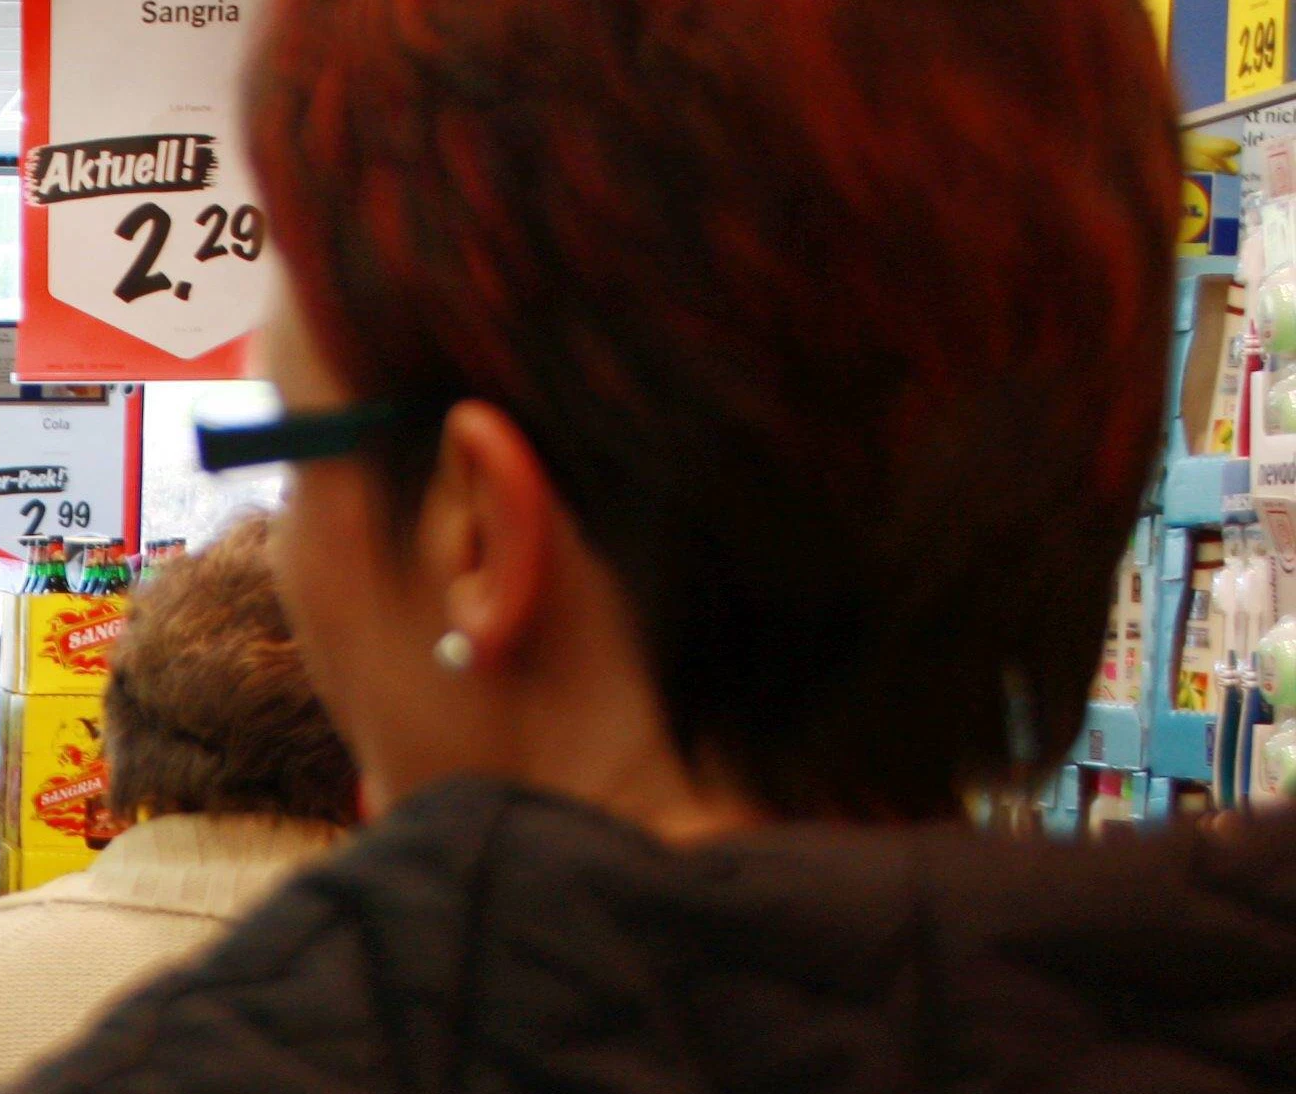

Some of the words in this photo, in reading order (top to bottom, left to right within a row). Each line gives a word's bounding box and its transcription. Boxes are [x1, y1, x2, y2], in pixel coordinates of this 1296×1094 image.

[142, 1, 240, 28] Sangria
[1237, 16, 1276, 79] 2.99
[38, 137, 197, 195] Aktuell!
[113, 202, 265, 304] 2.29
[42, 417, 71, 431] Cola
[68, 618, 128, 649] SANG
[40, 776, 104, 805] SANGRIA
